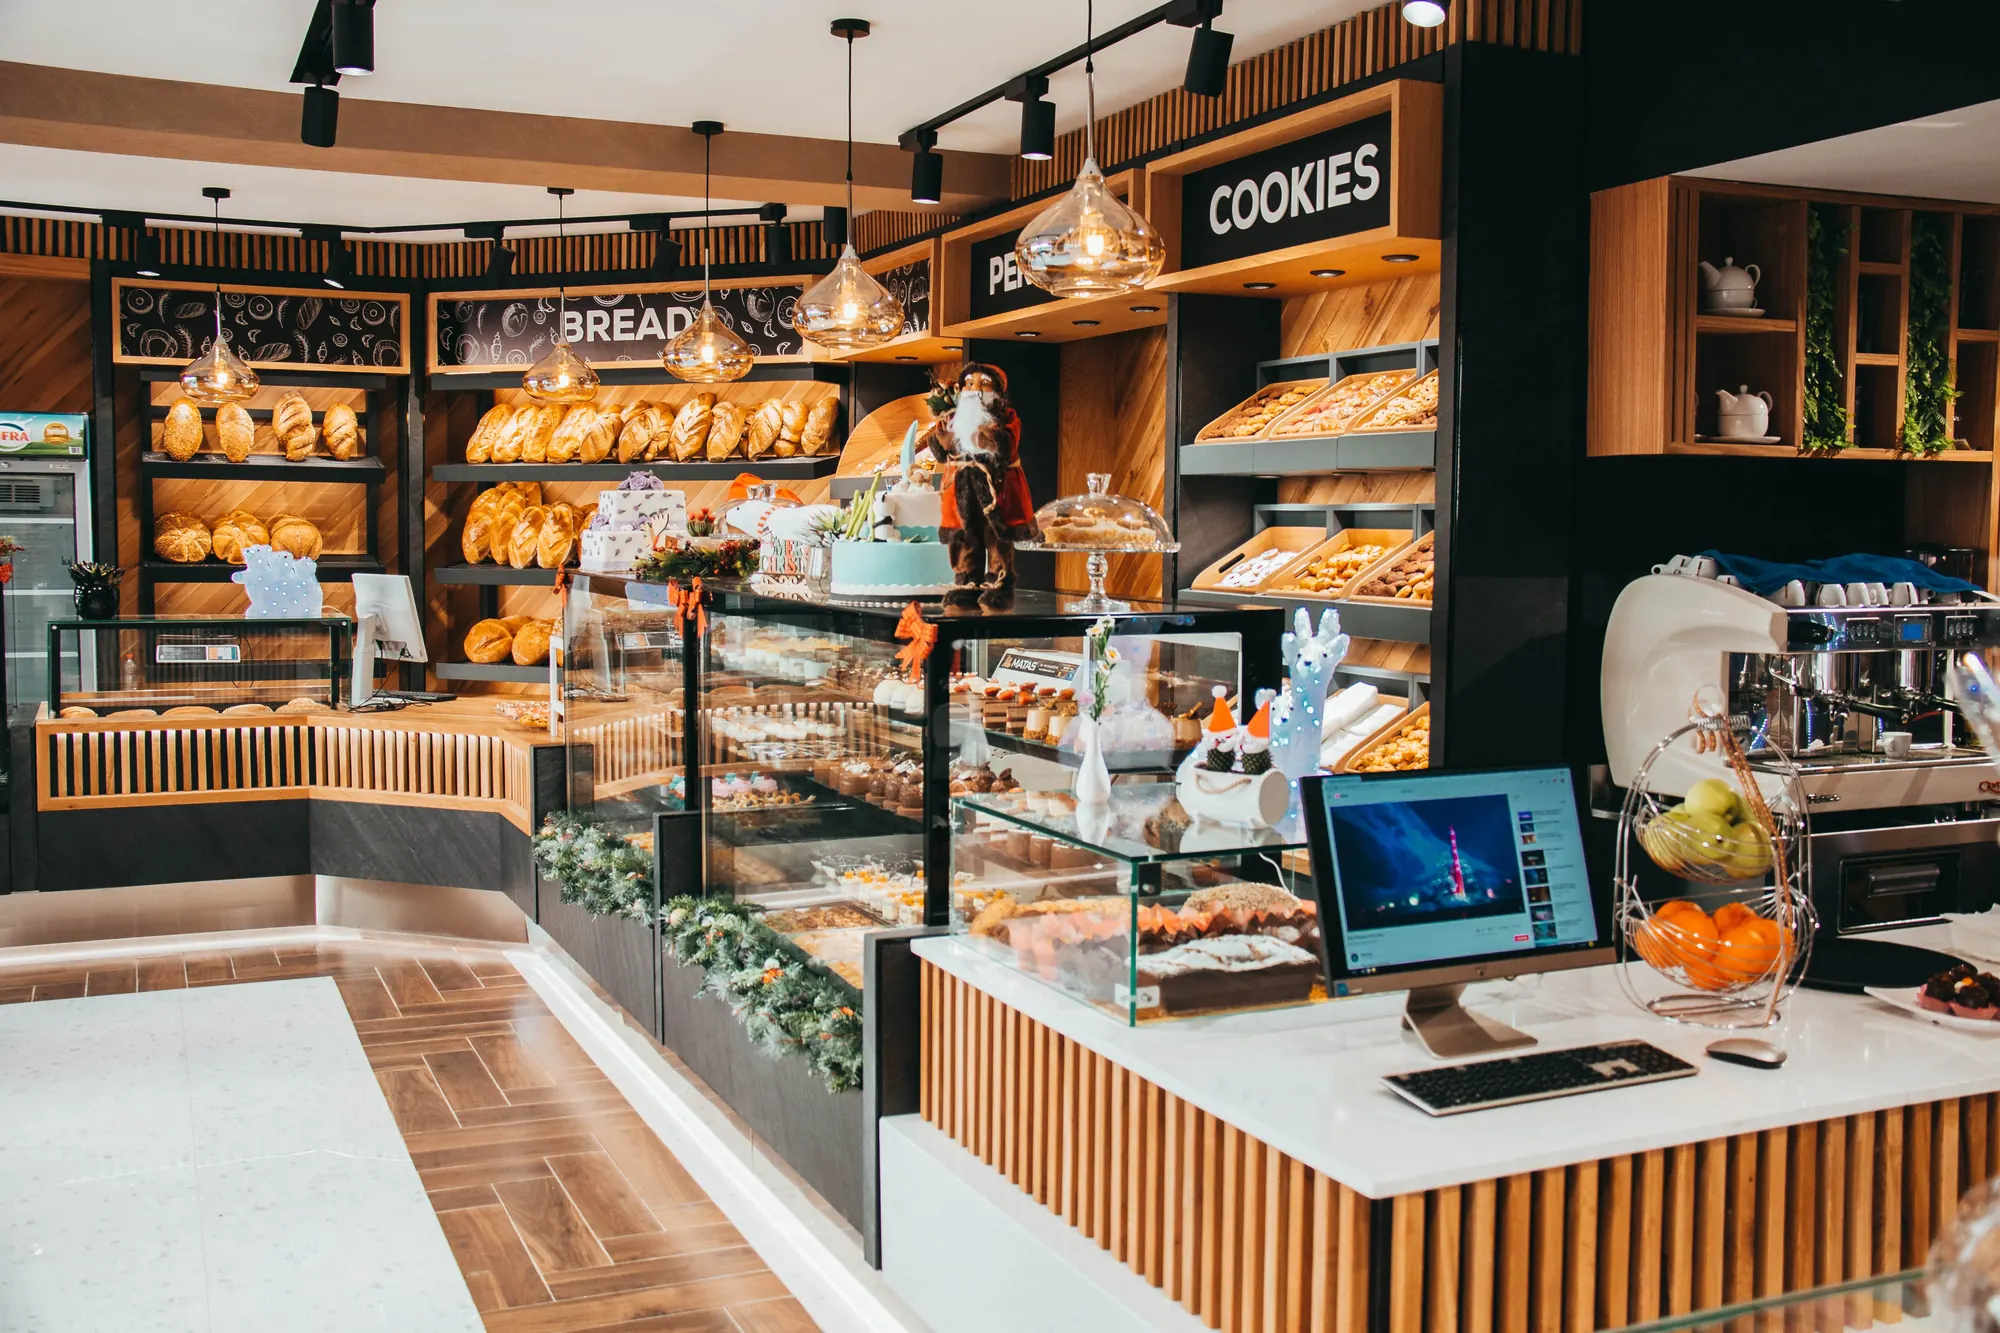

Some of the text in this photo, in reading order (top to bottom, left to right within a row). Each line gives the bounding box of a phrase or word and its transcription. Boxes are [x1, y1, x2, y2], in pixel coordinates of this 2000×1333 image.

[1209, 143, 1380, 235] COOKIES
[561, 307, 692, 342] BREAD
[0, 431, 29, 442] FRA
[1011, 658, 1038, 671] MATAS
